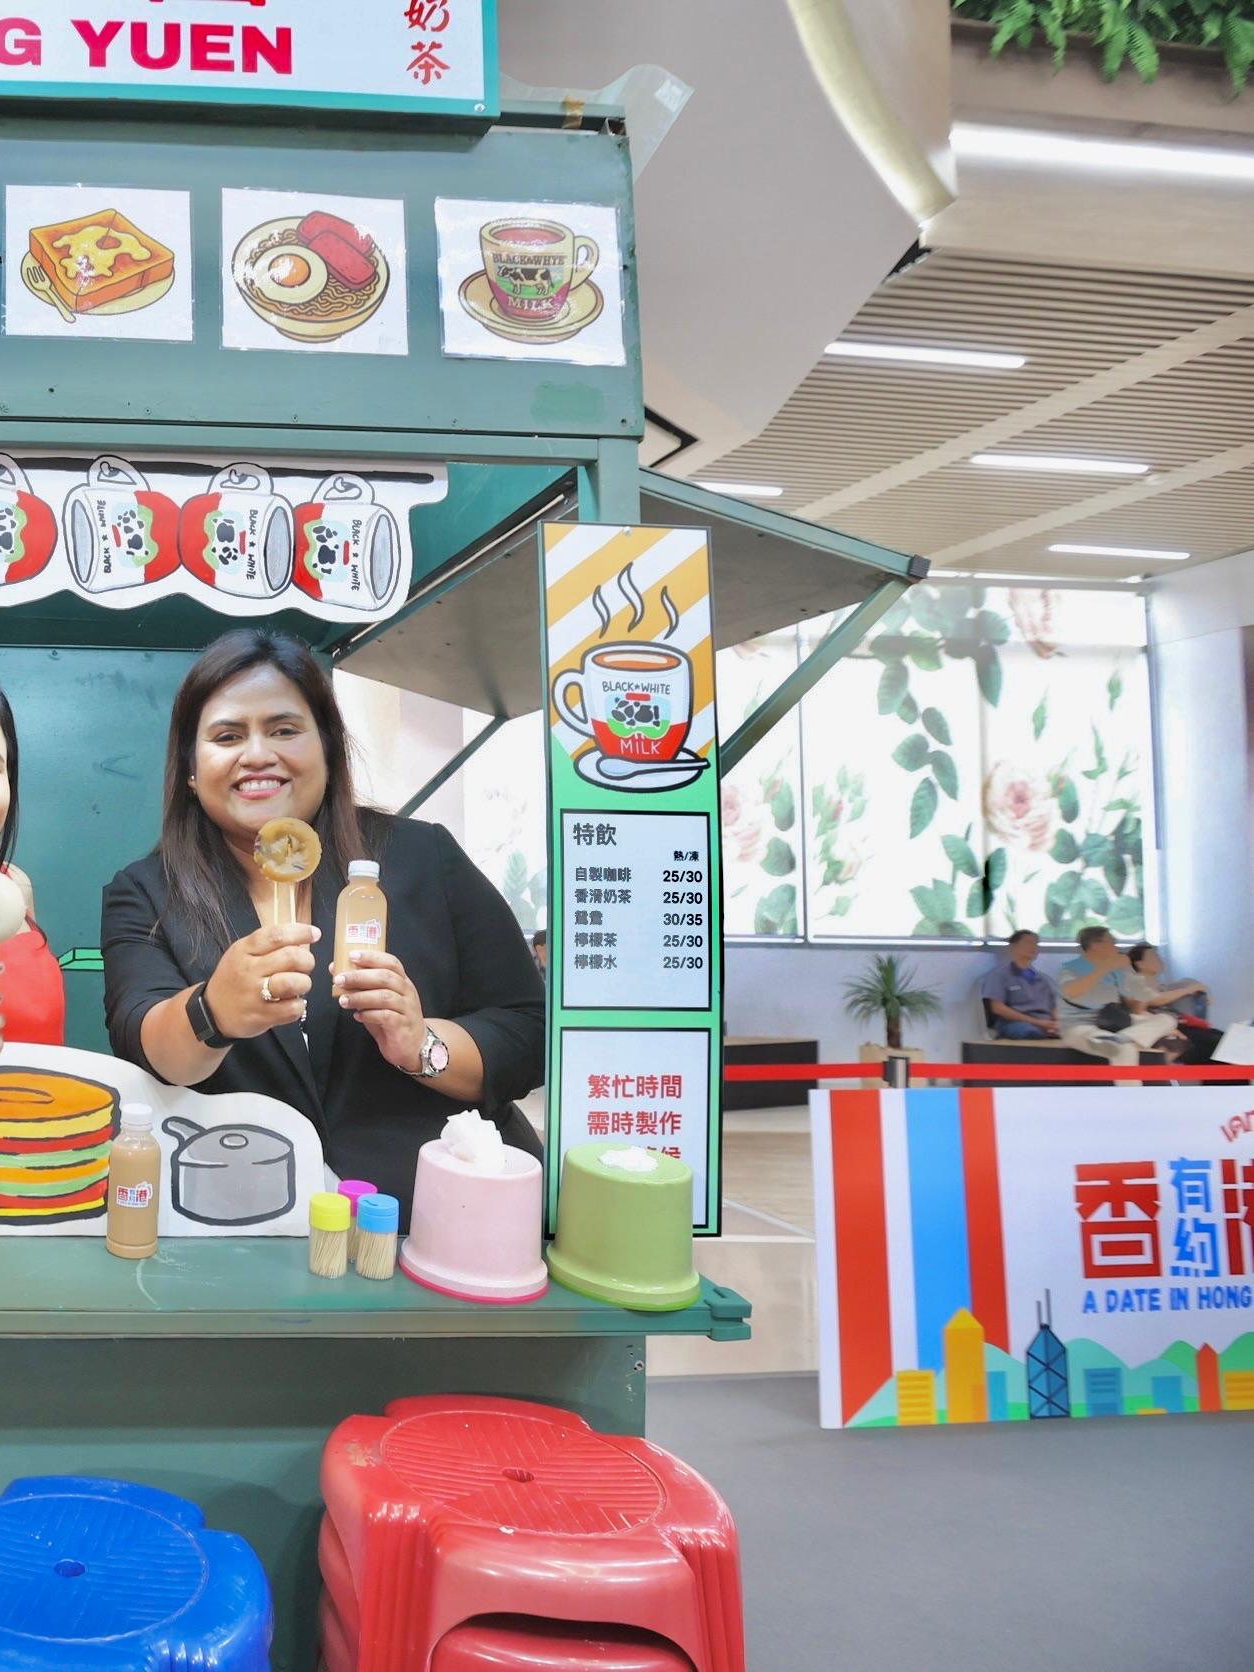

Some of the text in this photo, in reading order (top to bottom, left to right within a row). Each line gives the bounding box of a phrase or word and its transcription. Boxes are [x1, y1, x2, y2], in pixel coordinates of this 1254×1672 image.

[70, 19, 292, 75] YUEN
[403, 0, 451, 86] 奶茶
[507, 296, 555, 312] MILK
[249, 509, 259, 536] BLACK
[351, 518, 363, 547] BLACK
[103, 546, 112, 574] BLACK
[601, 680, 672, 695] BLACK WHITE
[619, 738, 660, 755] MILK
[572, 822, 618, 846] 特飲
[574, 866, 703, 883] 自製咖啡 25/30
[574, 888, 703, 905] 香滑奶茶 25/30
[663, 913, 703, 926] 30/35
[663, 934, 703, 948] 25/30
[663, 956, 703, 969] 25/30
[587, 1074, 683, 1099] 繁忙時間
[586, 1110, 683, 1136] 需時製作
[1082, 1285, 1253, 1314] A DATE IN HONG
